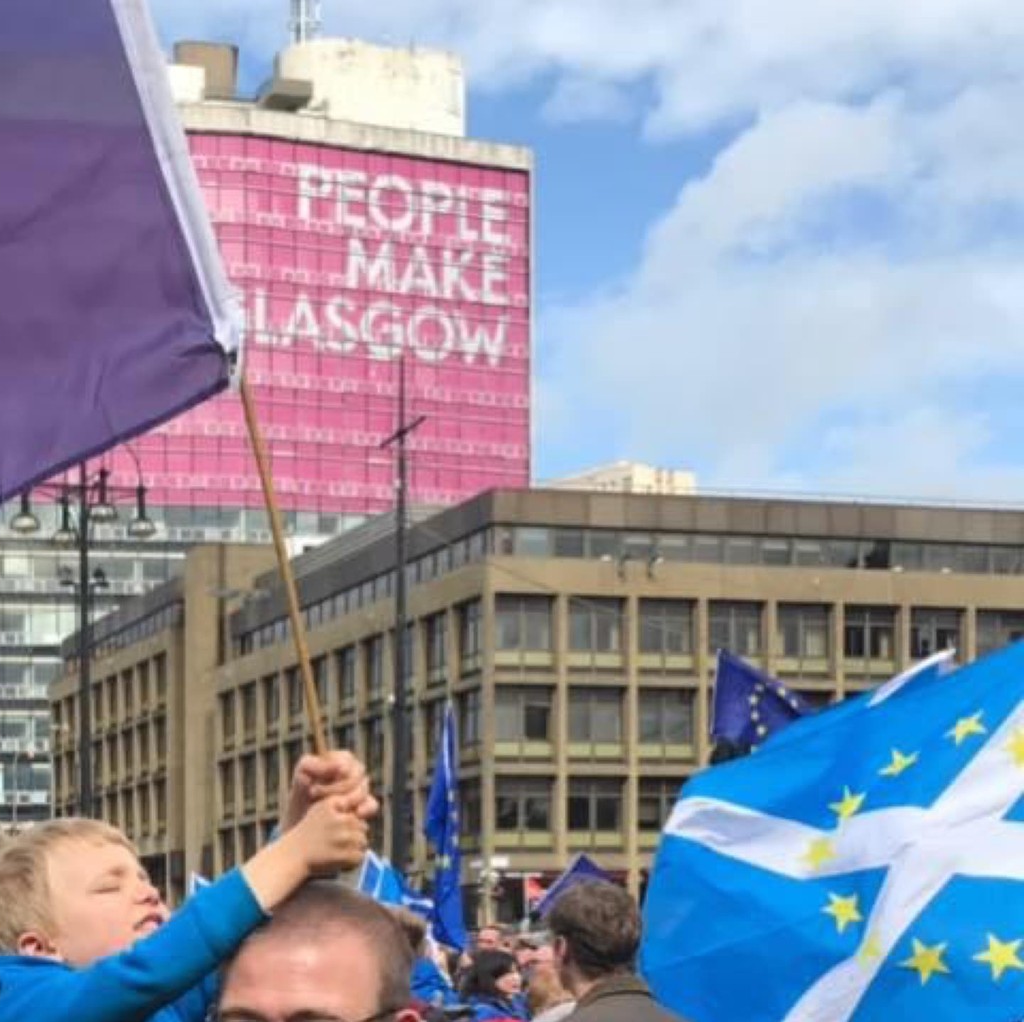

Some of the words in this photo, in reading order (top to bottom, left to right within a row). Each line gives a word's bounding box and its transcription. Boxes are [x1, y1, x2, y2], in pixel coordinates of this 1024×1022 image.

[297, 164, 512, 244] PEOPLE
[345, 237, 512, 305] MAKE
[253, 286, 512, 366] LASGOW
